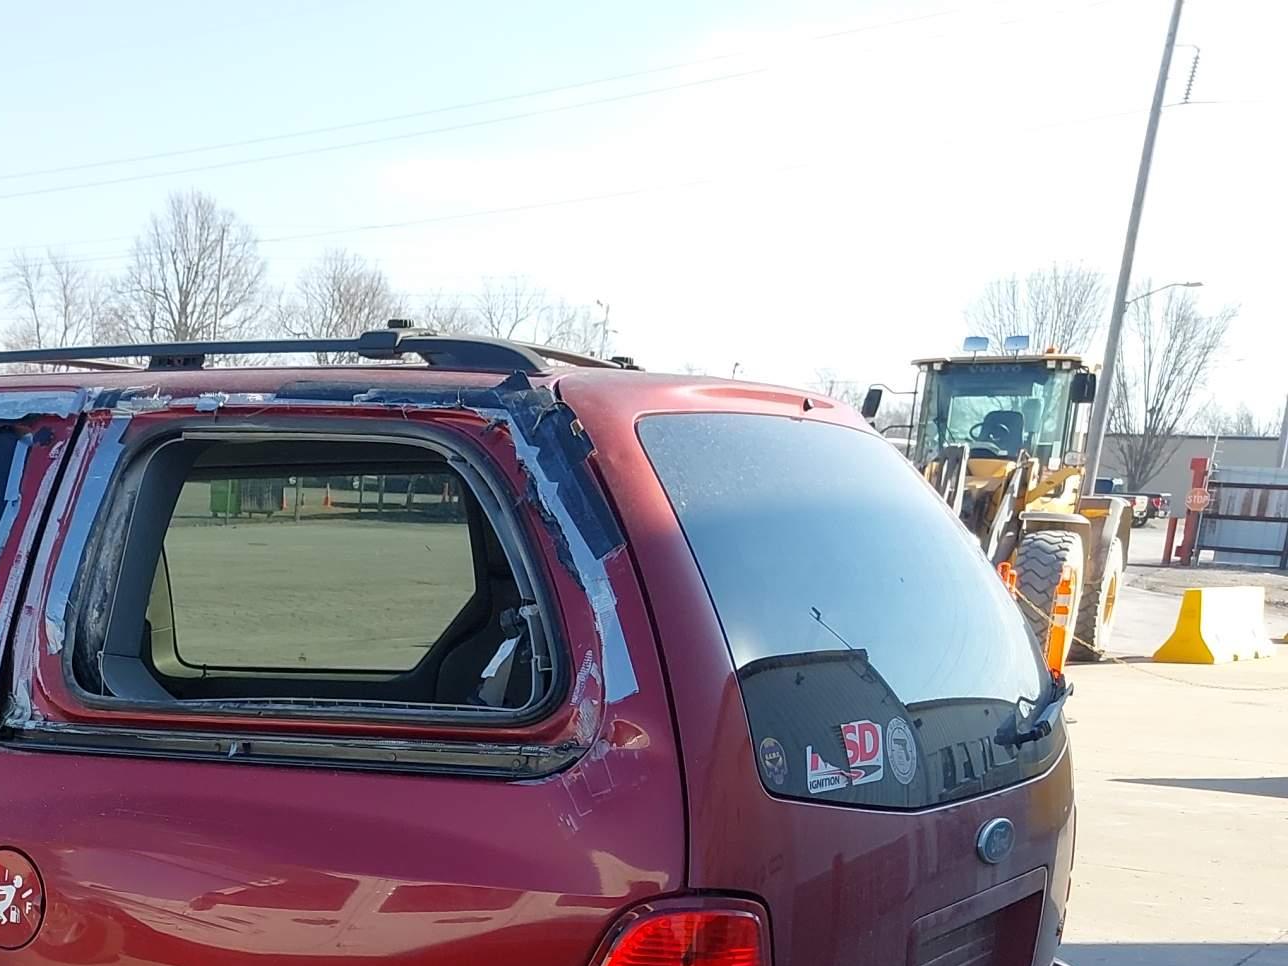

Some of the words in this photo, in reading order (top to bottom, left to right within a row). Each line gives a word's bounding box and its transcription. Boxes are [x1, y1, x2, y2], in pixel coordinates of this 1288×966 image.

[1186, 495, 1209, 505] STOP
[809, 775, 841, 791] IGNITION
[25, 902, 33, 914] F
